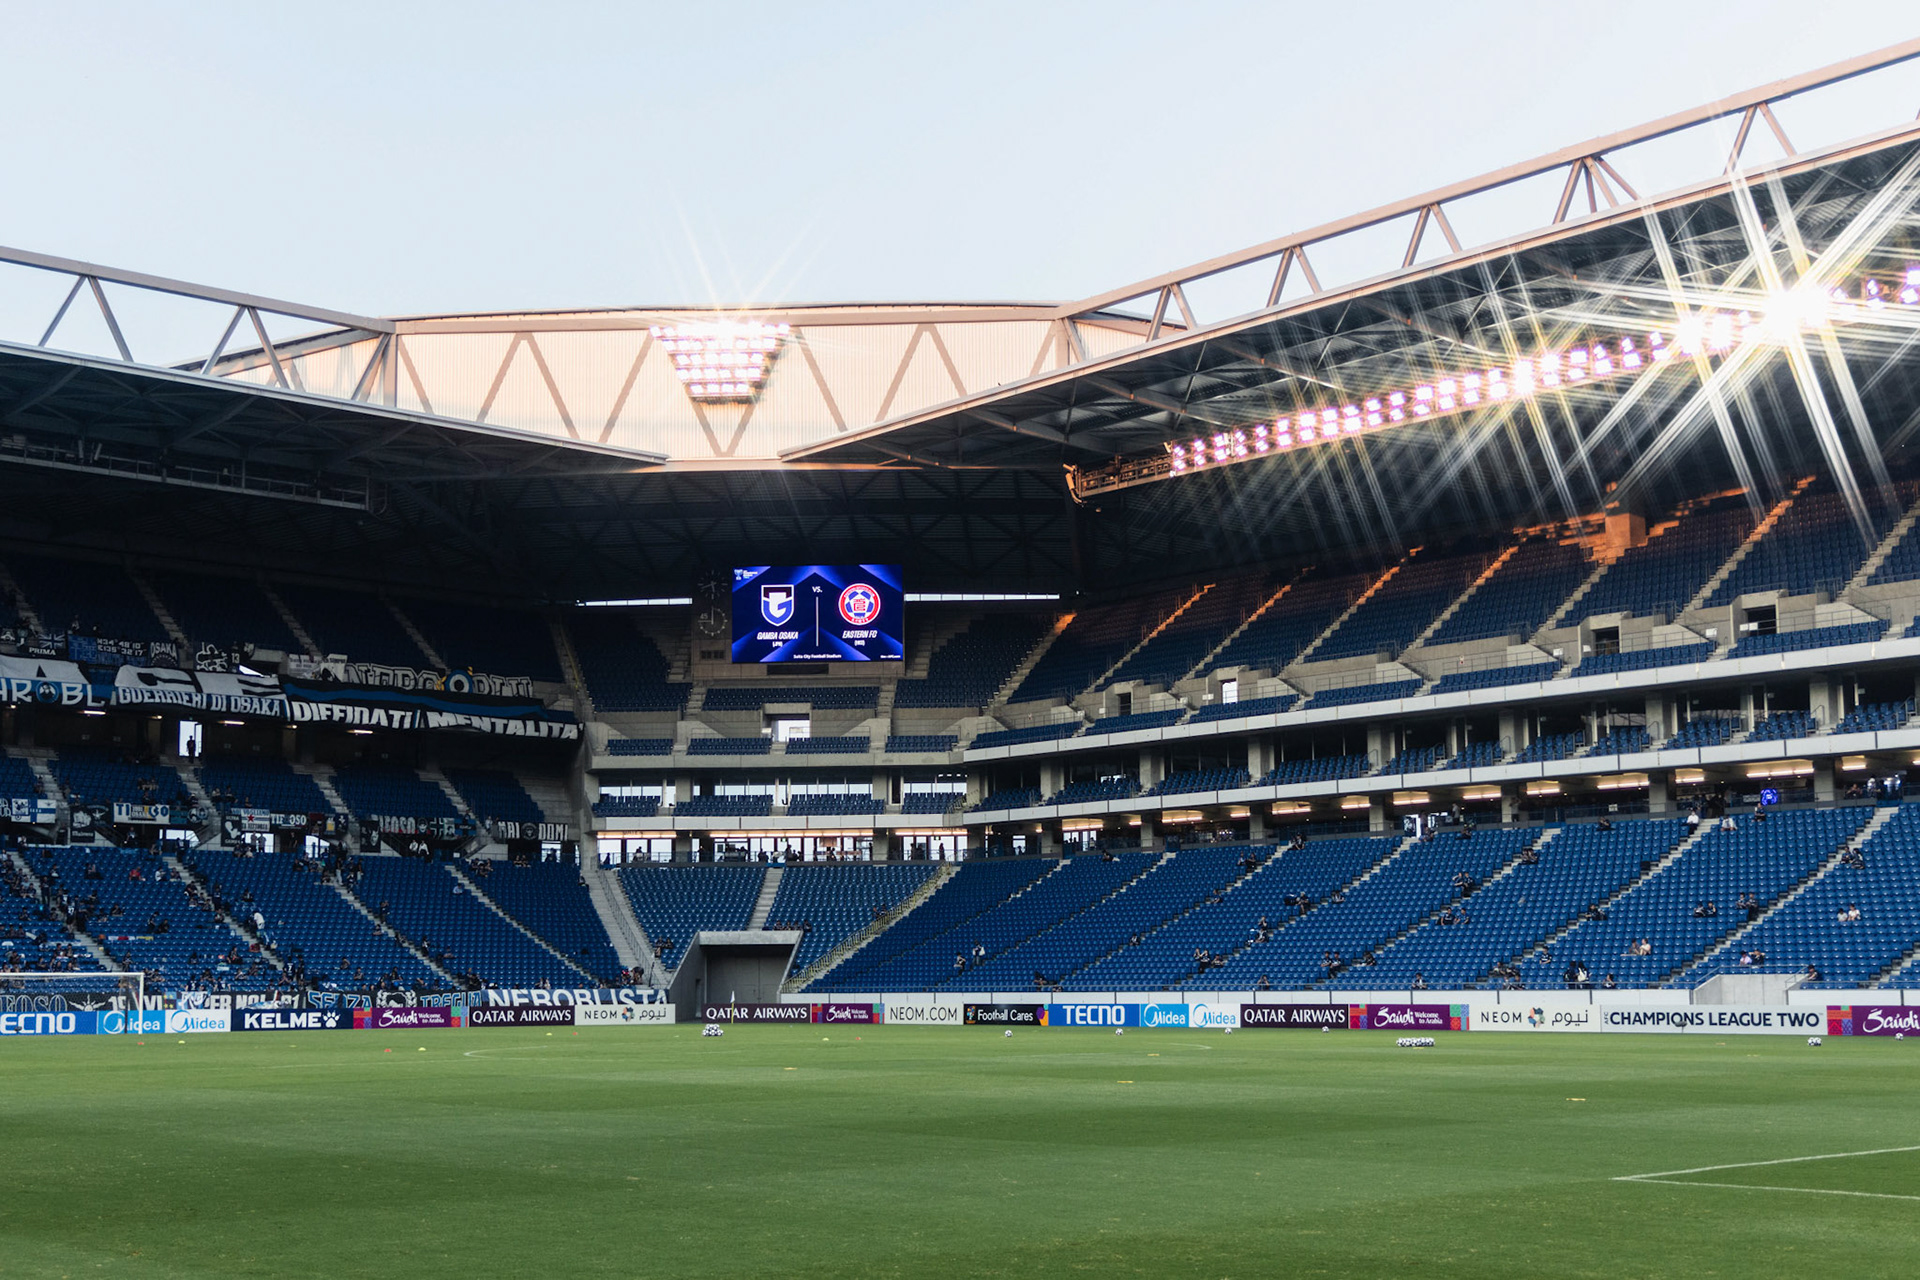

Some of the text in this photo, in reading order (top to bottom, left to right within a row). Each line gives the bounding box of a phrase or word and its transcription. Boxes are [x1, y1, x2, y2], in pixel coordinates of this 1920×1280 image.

[757, 631, 799, 640] GAMBA OSAKA
[842, 630, 878, 639] EASTERN FC
[29, 647, 56, 656] PRIMA
[150, 642, 177, 659] OSAKA
[119, 687, 280, 717] GUERRIERI DI OSAKA
[244, 1012, 322, 1029] KELME
[472, 1009, 571, 1024] QATAR AIRWAYS
[584, 1010, 618, 1020] NEOM
[639, 1007, 667, 1021] نيوم
[706, 1007, 807, 1020] QATAR AIRWAYS
[890, 1007, 958, 1021] NEOM.COM
[977, 1009, 1034, 1021] Football Cares
[1062, 1005, 1125, 1025] TECNO
[1244, 1008, 1345, 1023] QATAR AIRWAYS
[1481, 1011, 1522, 1023] NEOM
[1551, 1009, 1588, 1027] نيوم
[1609, 1011, 1820, 1027] CHAMPIONS LEAGUE TWO
